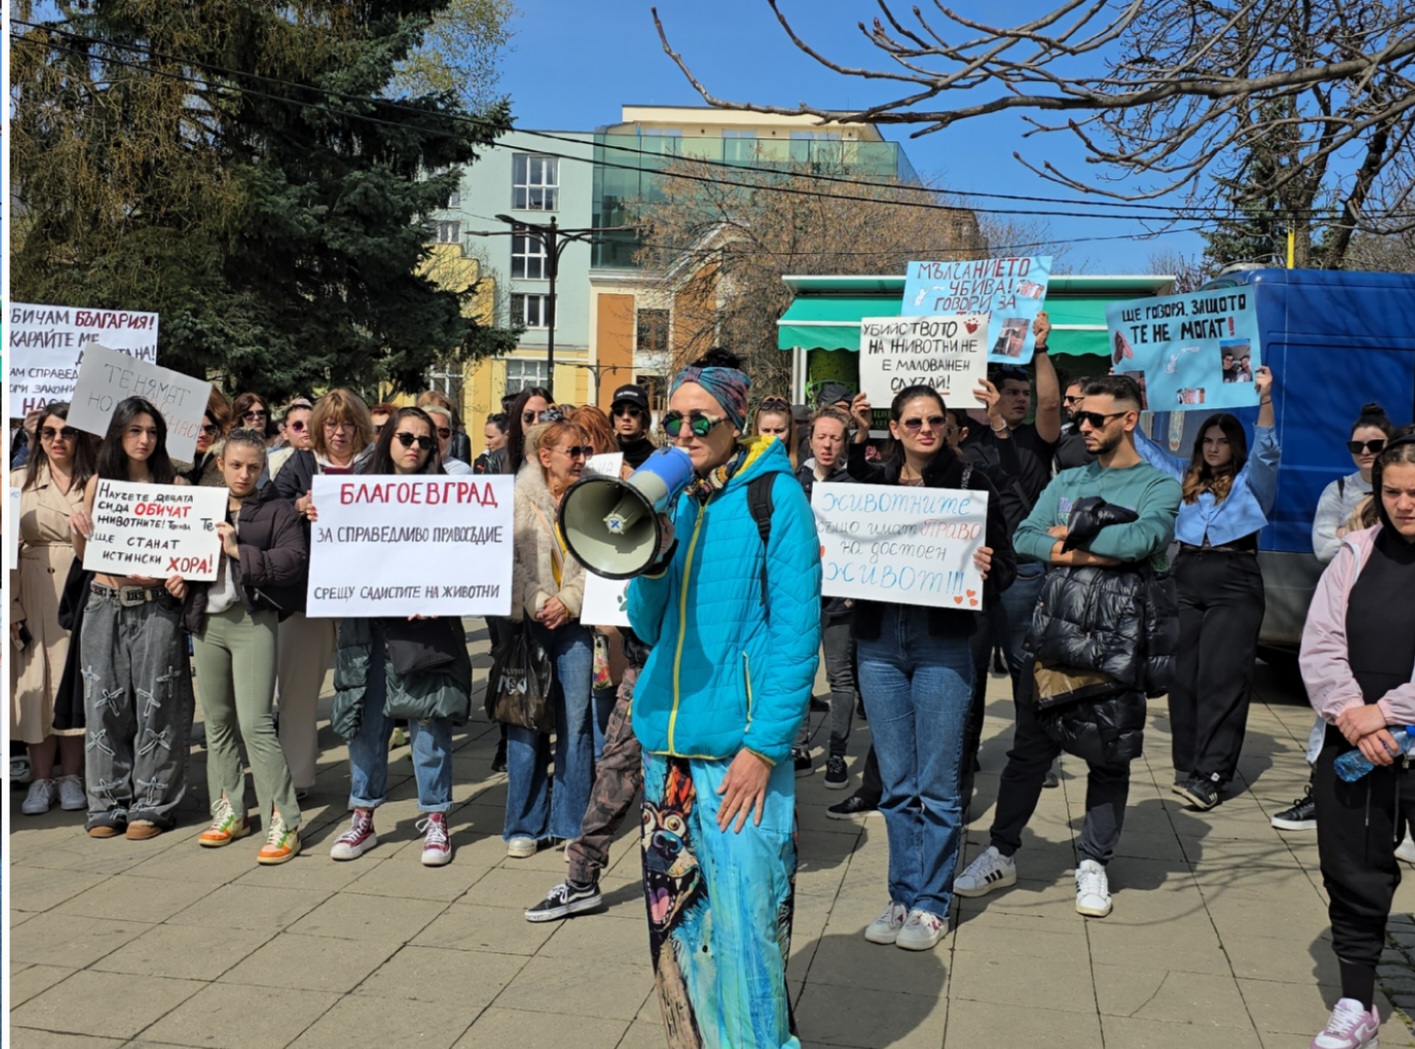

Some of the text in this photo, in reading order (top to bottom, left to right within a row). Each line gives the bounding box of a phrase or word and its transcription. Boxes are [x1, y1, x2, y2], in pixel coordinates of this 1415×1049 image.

[917, 258, 1031, 280] МЪЛЧАНИЕТО
[949, 278, 1014, 297] УБИВА!
[934, 294, 1016, 311] ГОВОРИ ЗА
[1122, 308, 1140, 322] ЩЕ
[1191, 293, 1246, 315] ЗАЩОТО
[10, 308, 155, 330] БИЧАМ БЪЛГАРИЯ!
[863, 321, 957, 338] УБИЙСТВОТО
[1130, 325, 1148, 343] ТЕ
[1153, 324, 1170, 343] НЕ
[869, 339, 978, 354] НА ЖИВОТНИ НЕ
[882, 359, 970, 371] Е МАЛОВАЖЕН
[88, 391, 113, 411] НО
[340, 482, 498, 508] БЛАГОЕВГРАД
[134, 502, 192, 518] ОБИЧАТ
[98, 515, 166, 529] ЖИВОТНИТЕ!
[94, 533, 180, 549] ЩЕ СТАНАТ
[317, 526, 503, 545] ЗА СПРАВЕДЛИВО ПРАВОСЪДИЕ
[103, 551, 213, 573] ИСТИНСКИ ХОРА!
[870, 541, 947, 564] достоен
[314, 584, 499, 601] СРЕЩУ САДИСТИТЕ НА ЖИВОТНИ
